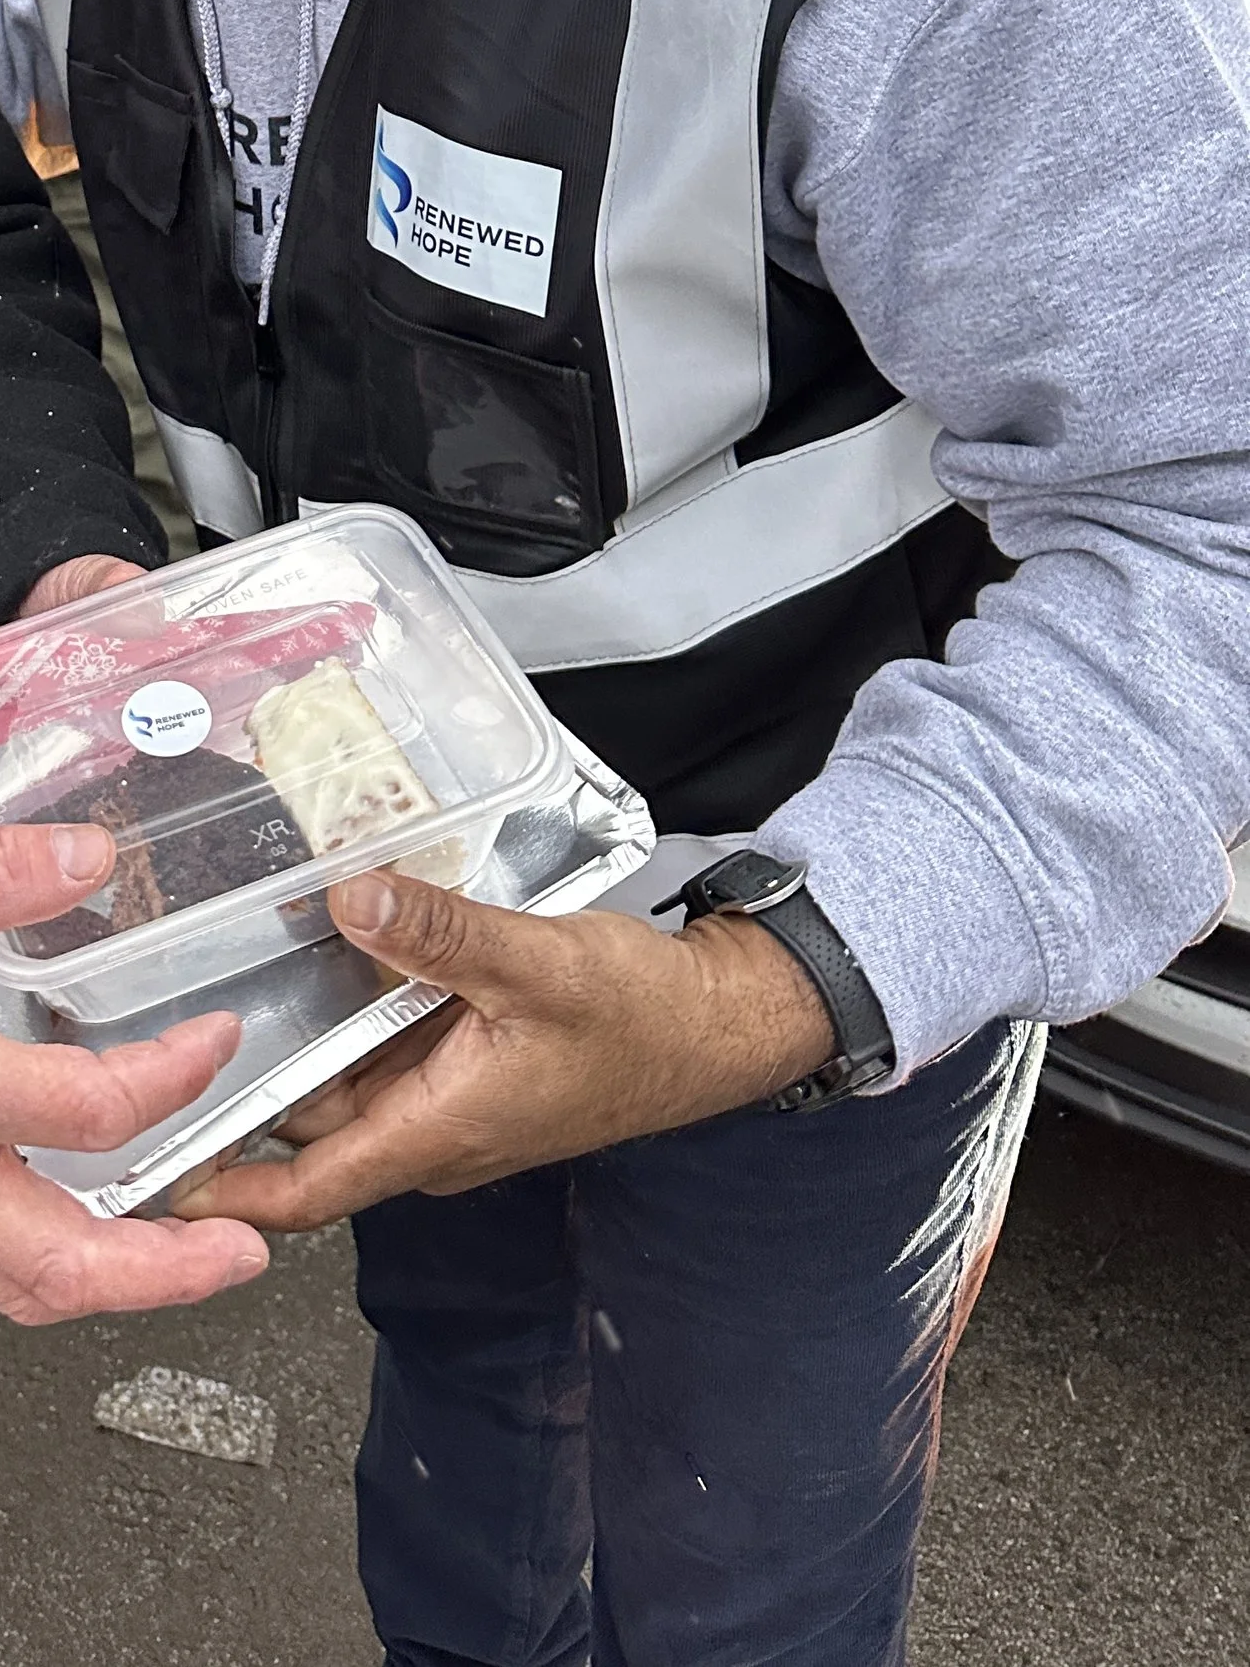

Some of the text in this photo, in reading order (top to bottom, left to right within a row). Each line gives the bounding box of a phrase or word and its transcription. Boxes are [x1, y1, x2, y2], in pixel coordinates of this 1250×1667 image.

[411, 223, 472, 268] HOPE
[414, 196, 545, 257] RENEWED
[205, 568, 308, 614] OVEN SAFE
[155, 708, 205, 724] RENEWED
[157, 721, 185, 732] HOPE
